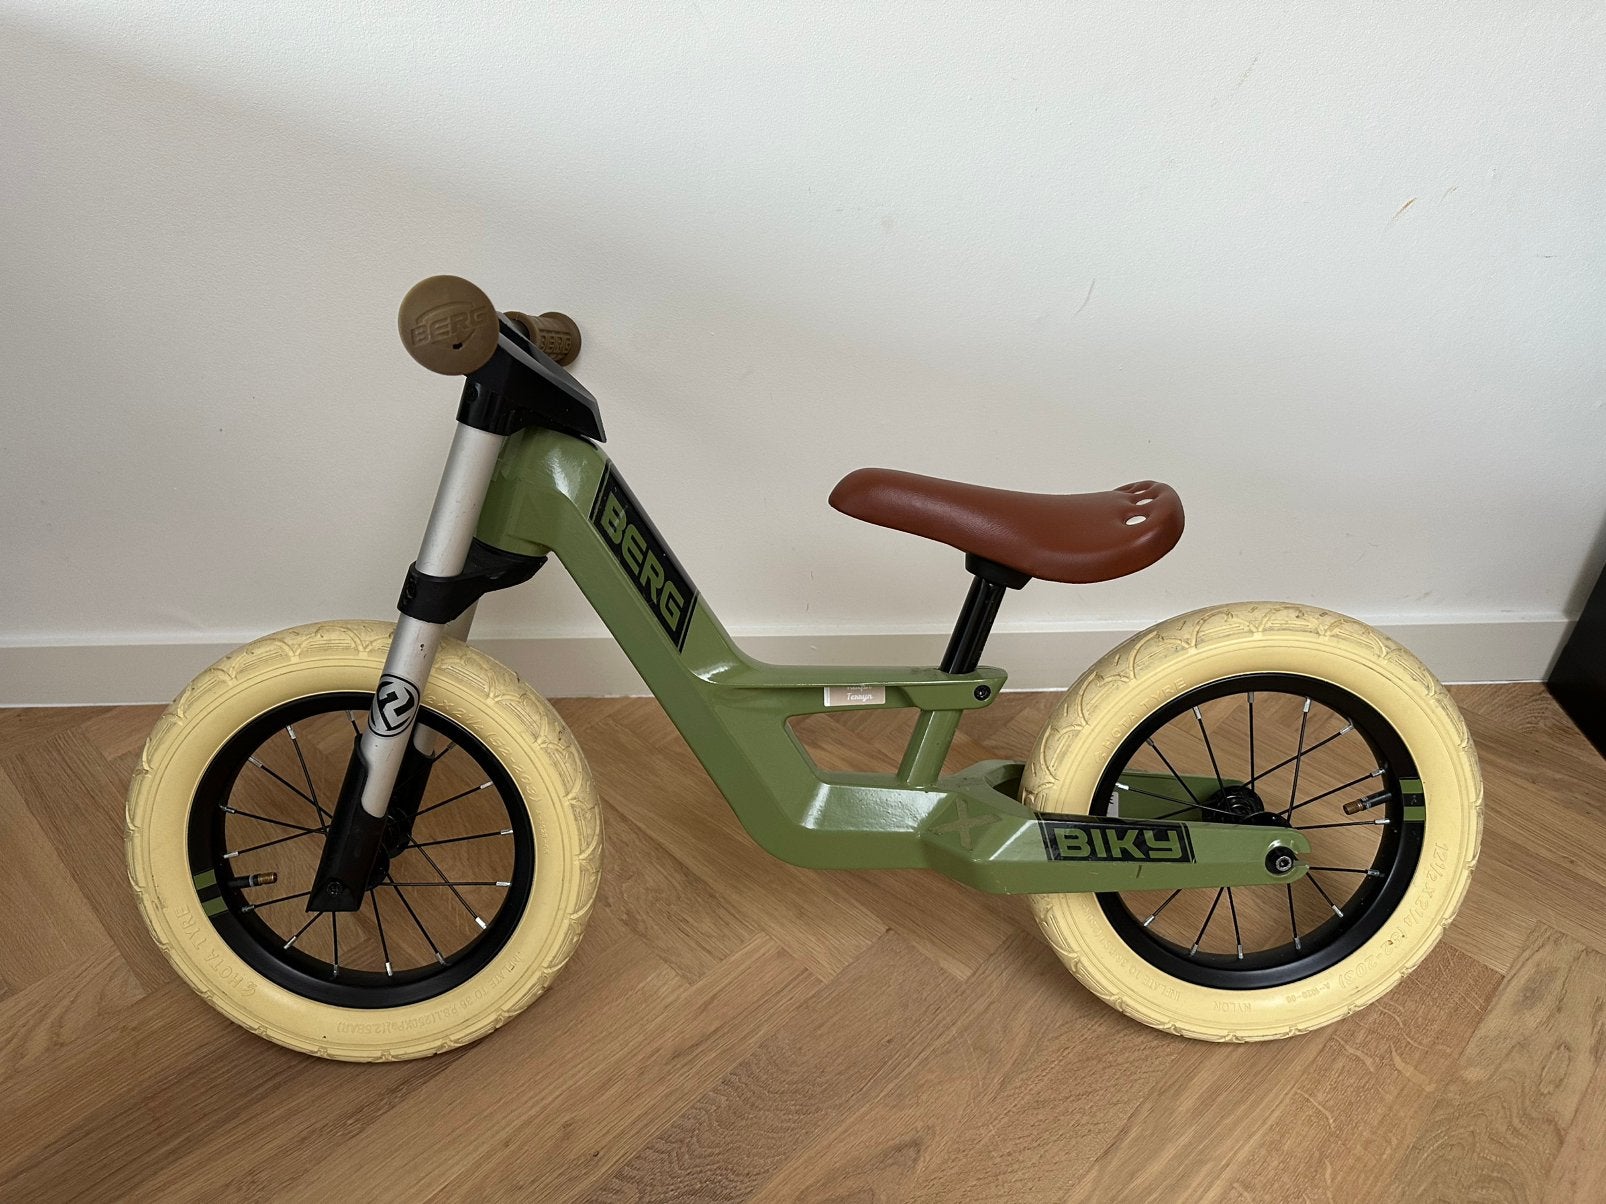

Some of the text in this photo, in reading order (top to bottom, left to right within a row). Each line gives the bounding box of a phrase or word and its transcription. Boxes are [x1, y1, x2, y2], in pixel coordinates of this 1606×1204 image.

[411, 305, 490, 347] BERG
[540, 334, 571, 353] BERG
[600, 491, 685, 632] BERG
[1141, 677, 1186, 710] TYRE
[1054, 828, 1182, 859] BIKY
[174, 904, 208, 950] TYRE
